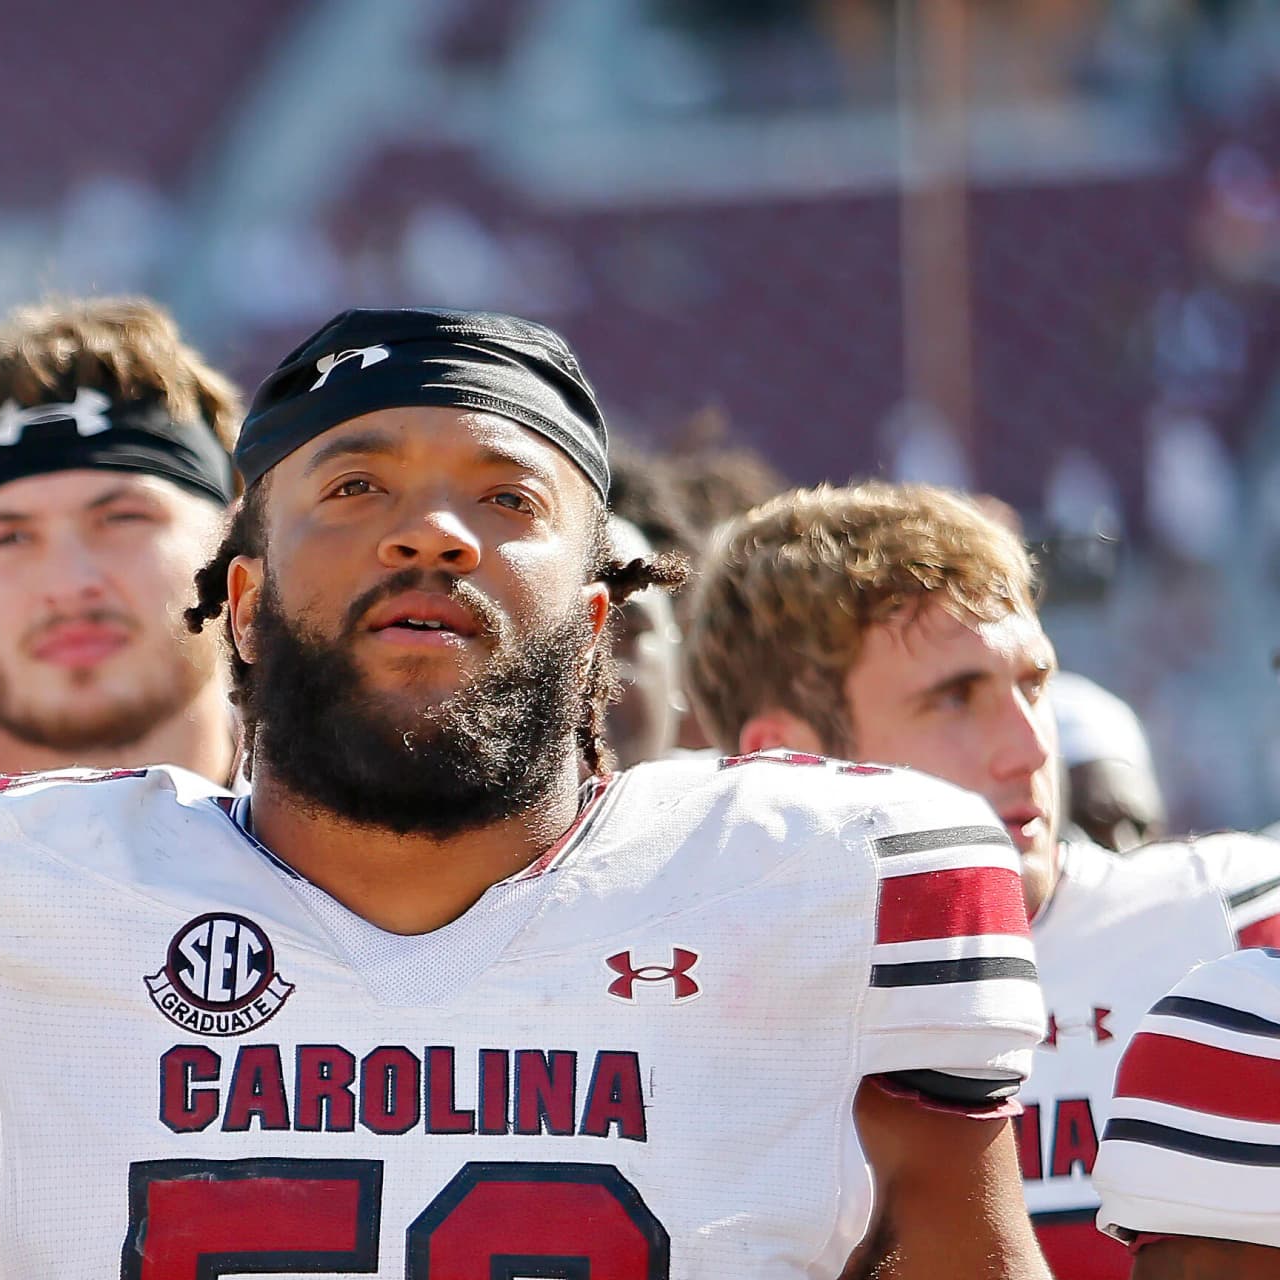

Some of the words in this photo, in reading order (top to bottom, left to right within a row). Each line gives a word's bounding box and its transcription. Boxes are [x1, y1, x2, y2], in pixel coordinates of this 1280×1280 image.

[178, 920, 263, 1002] SEC
[161, 997, 272, 1033] GRADUATE
[159, 1043, 648, 1143] CAROLINA
